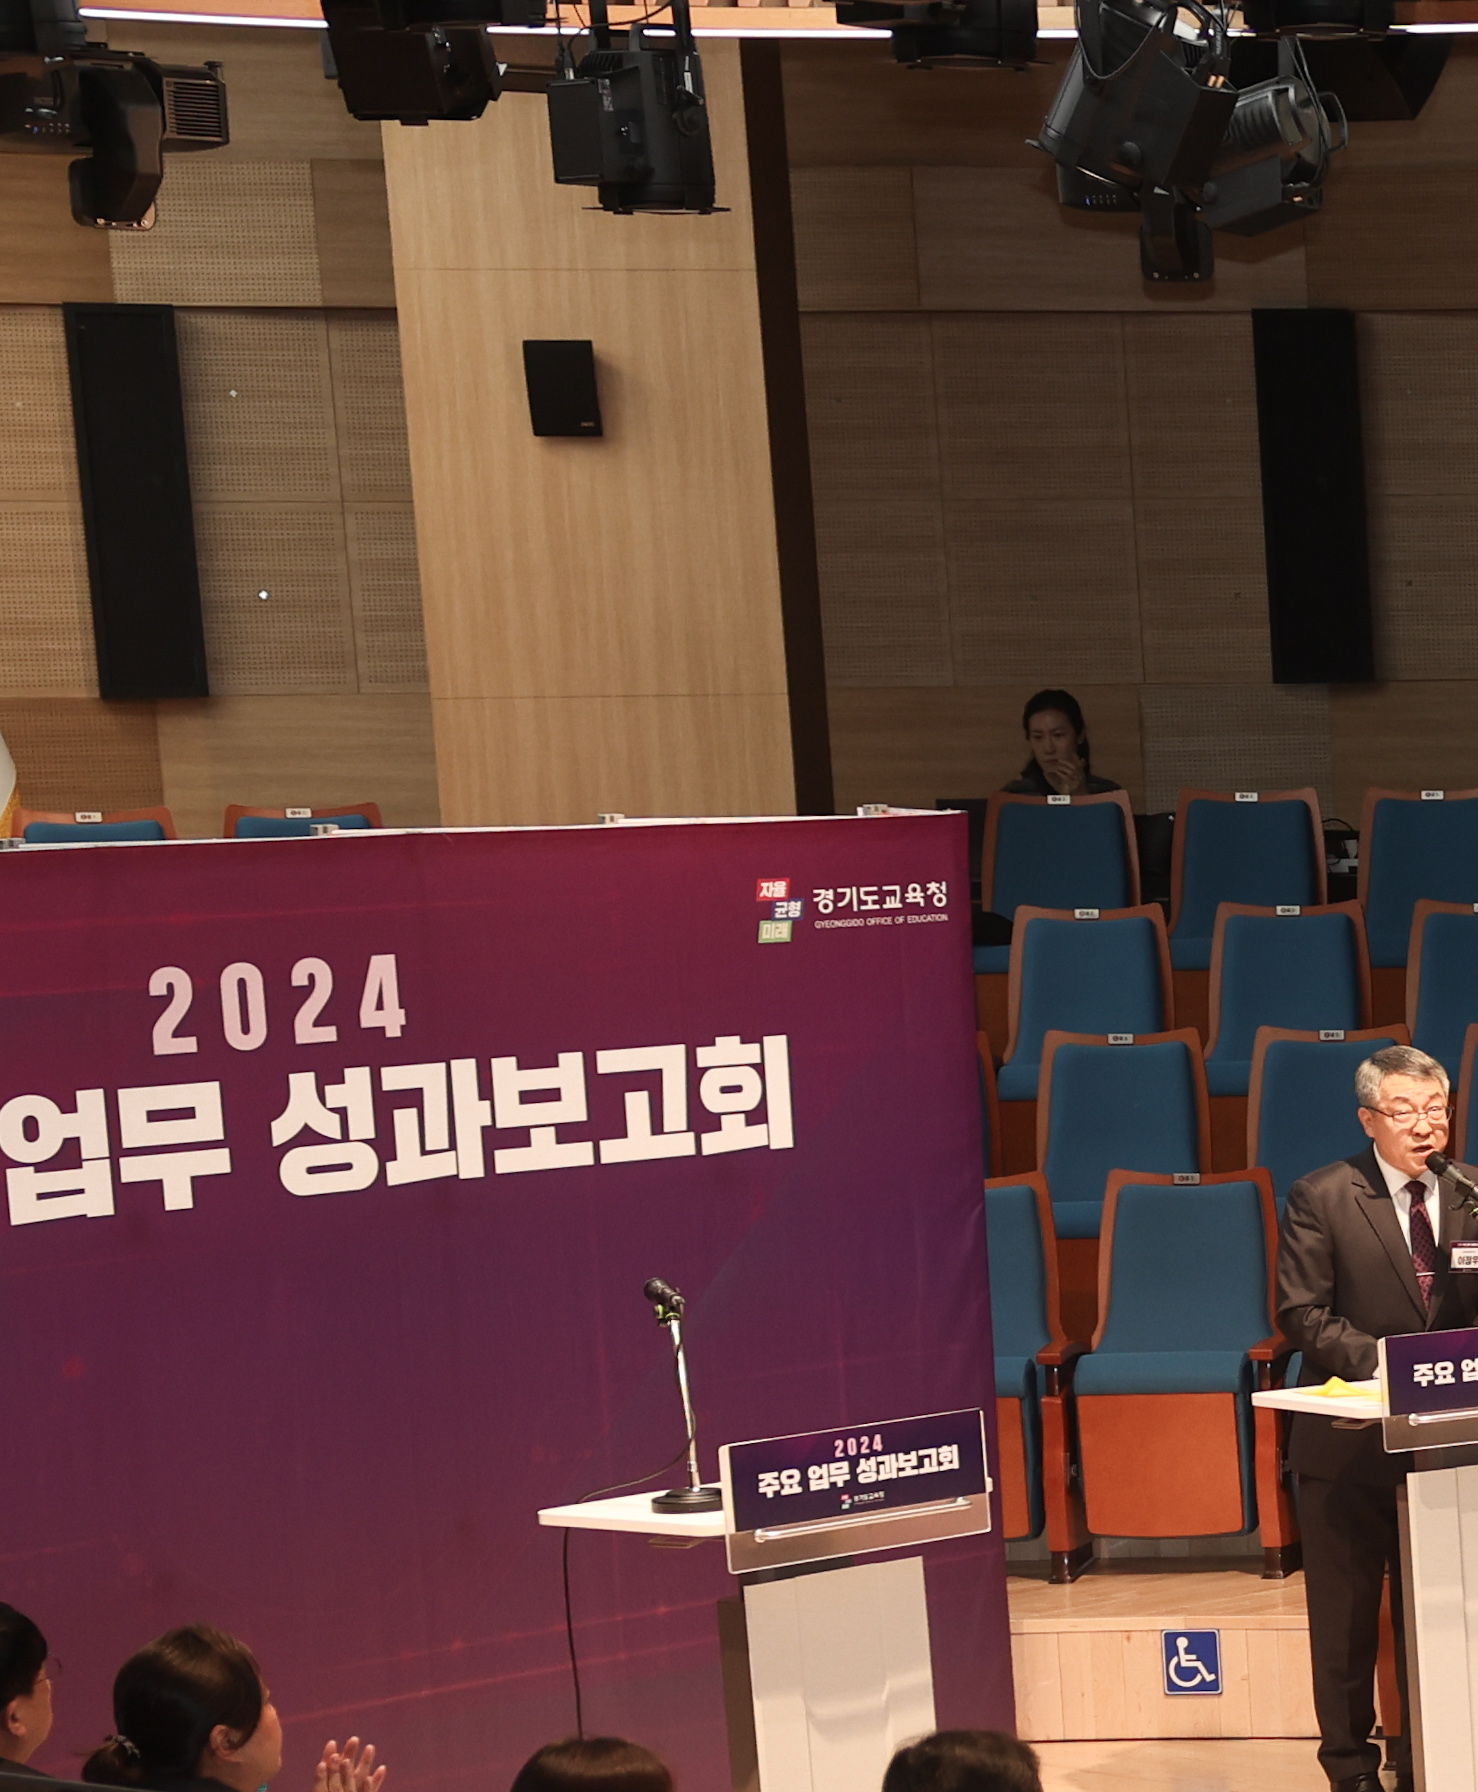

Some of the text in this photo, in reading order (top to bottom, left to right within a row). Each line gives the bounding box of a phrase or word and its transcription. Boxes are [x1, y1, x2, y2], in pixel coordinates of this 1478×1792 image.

[759, 881, 787, 899] 자율
[812, 881, 948, 914] 경기도교육청
[774, 901, 802, 918] 균형
[814, 913, 949, 929] GYEONGGIDO OFFICE OF EDUCATION
[761, 922, 788, 940] 미래
[148, 952, 407, 1056] 2024
[0, 1033, 796, 1227] 업무 성과보고회
[1413, 1361, 1455, 1387] 주요
[834, 1433, 884, 1458] 2024
[758, 1444, 960, 1499] 주요 업무 성과보고회
